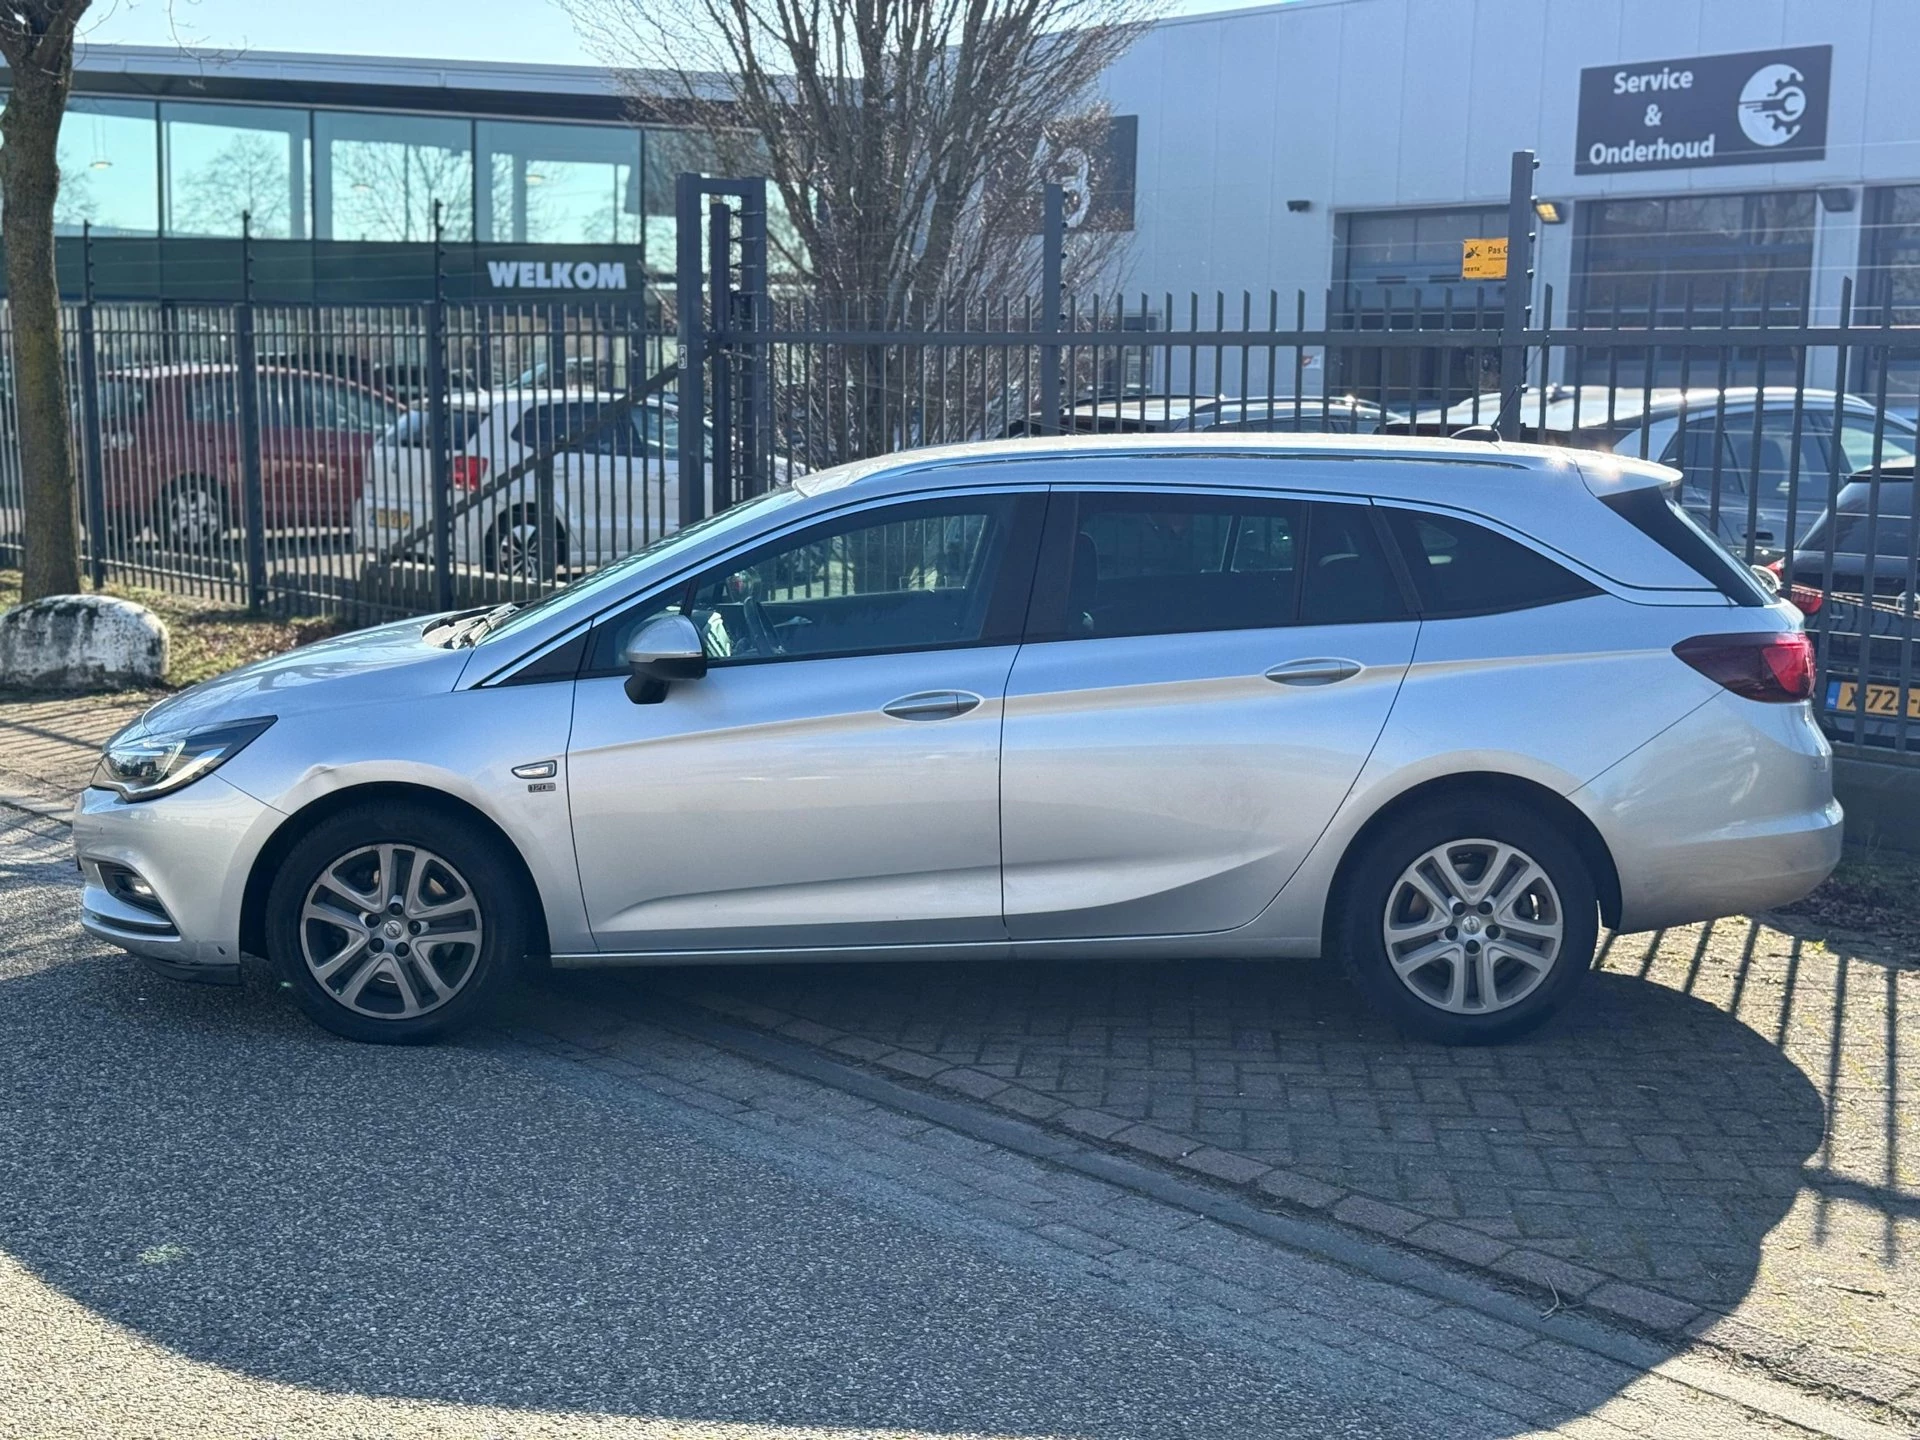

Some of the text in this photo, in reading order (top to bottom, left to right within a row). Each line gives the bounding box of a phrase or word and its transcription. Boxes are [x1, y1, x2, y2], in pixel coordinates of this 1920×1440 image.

[1613, 67, 1693, 94] Service
[1644, 104, 1663, 127] &
[1589, 134, 1716, 165] Onderhoud
[1488, 246, 1501, 254] Pas
[487, 261, 628, 289] WELKOM
